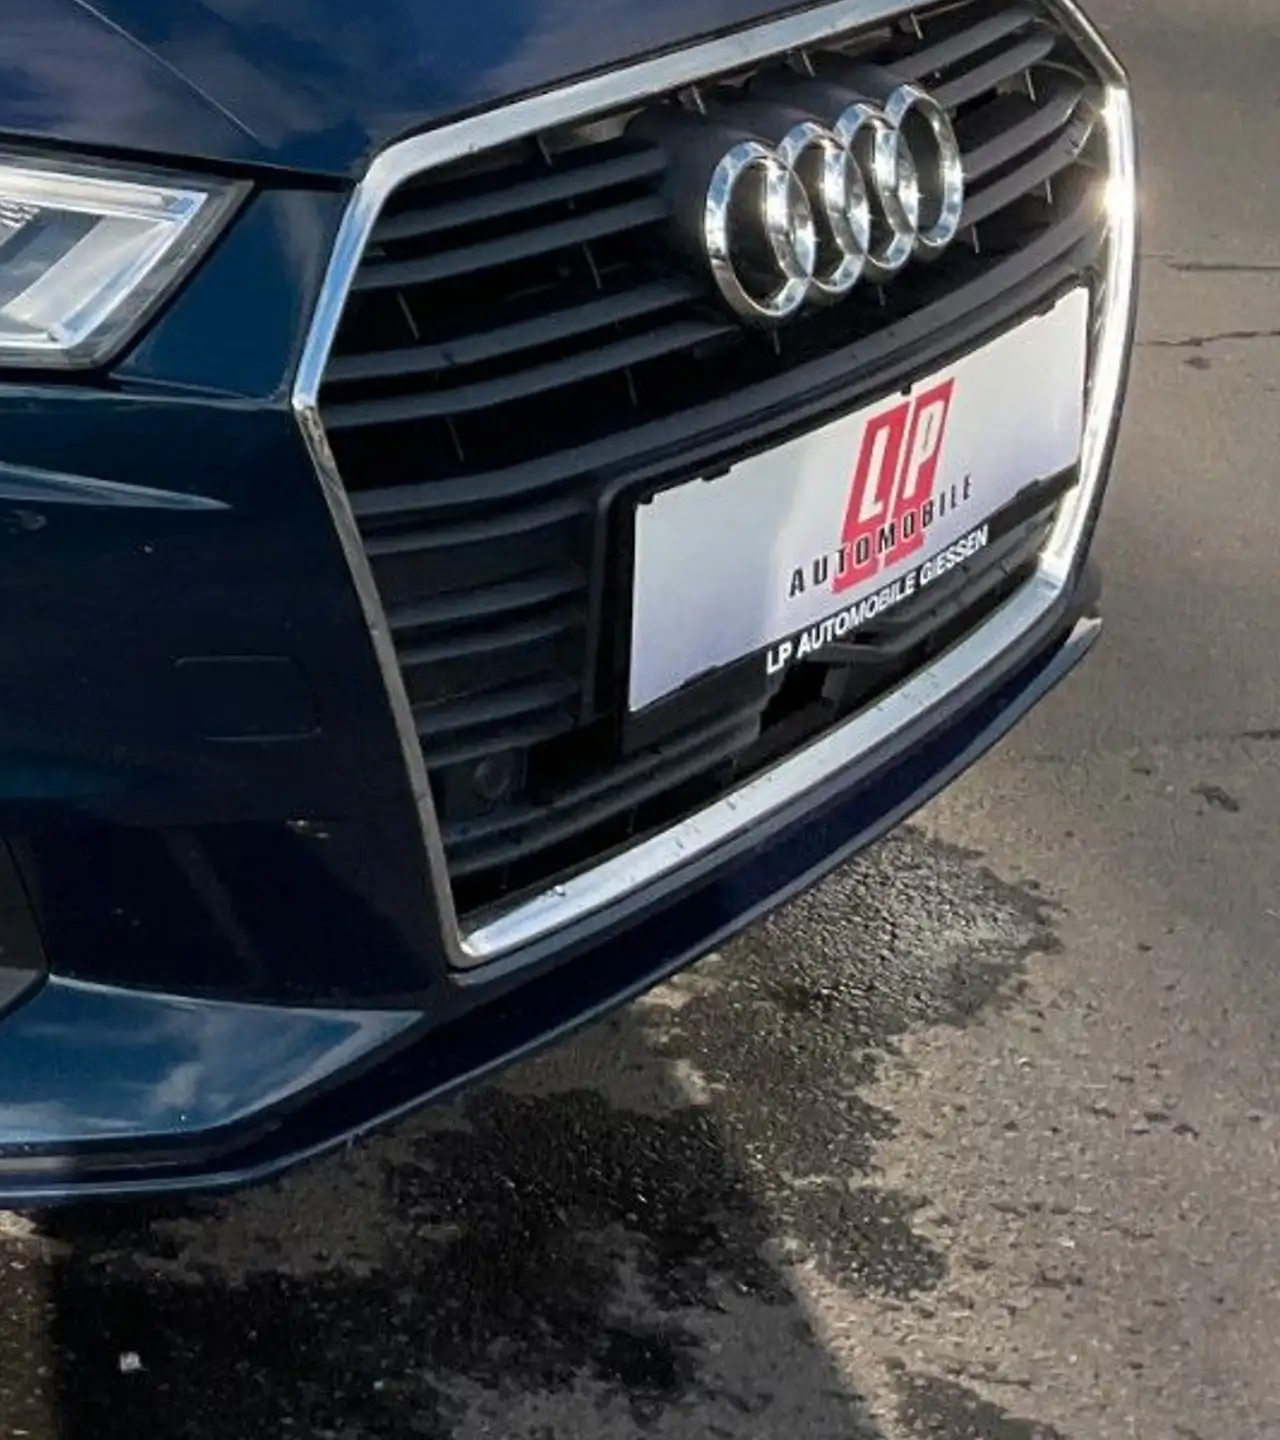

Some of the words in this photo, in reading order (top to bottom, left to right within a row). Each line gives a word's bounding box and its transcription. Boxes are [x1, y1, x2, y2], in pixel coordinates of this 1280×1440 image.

[766, 644, 793, 676] LP
[796, 575, 917, 660] AUTOMOBILE
[919, 523, 989, 592] GIESSEN
[786, 472, 974, 600] AUTOMOBILE
